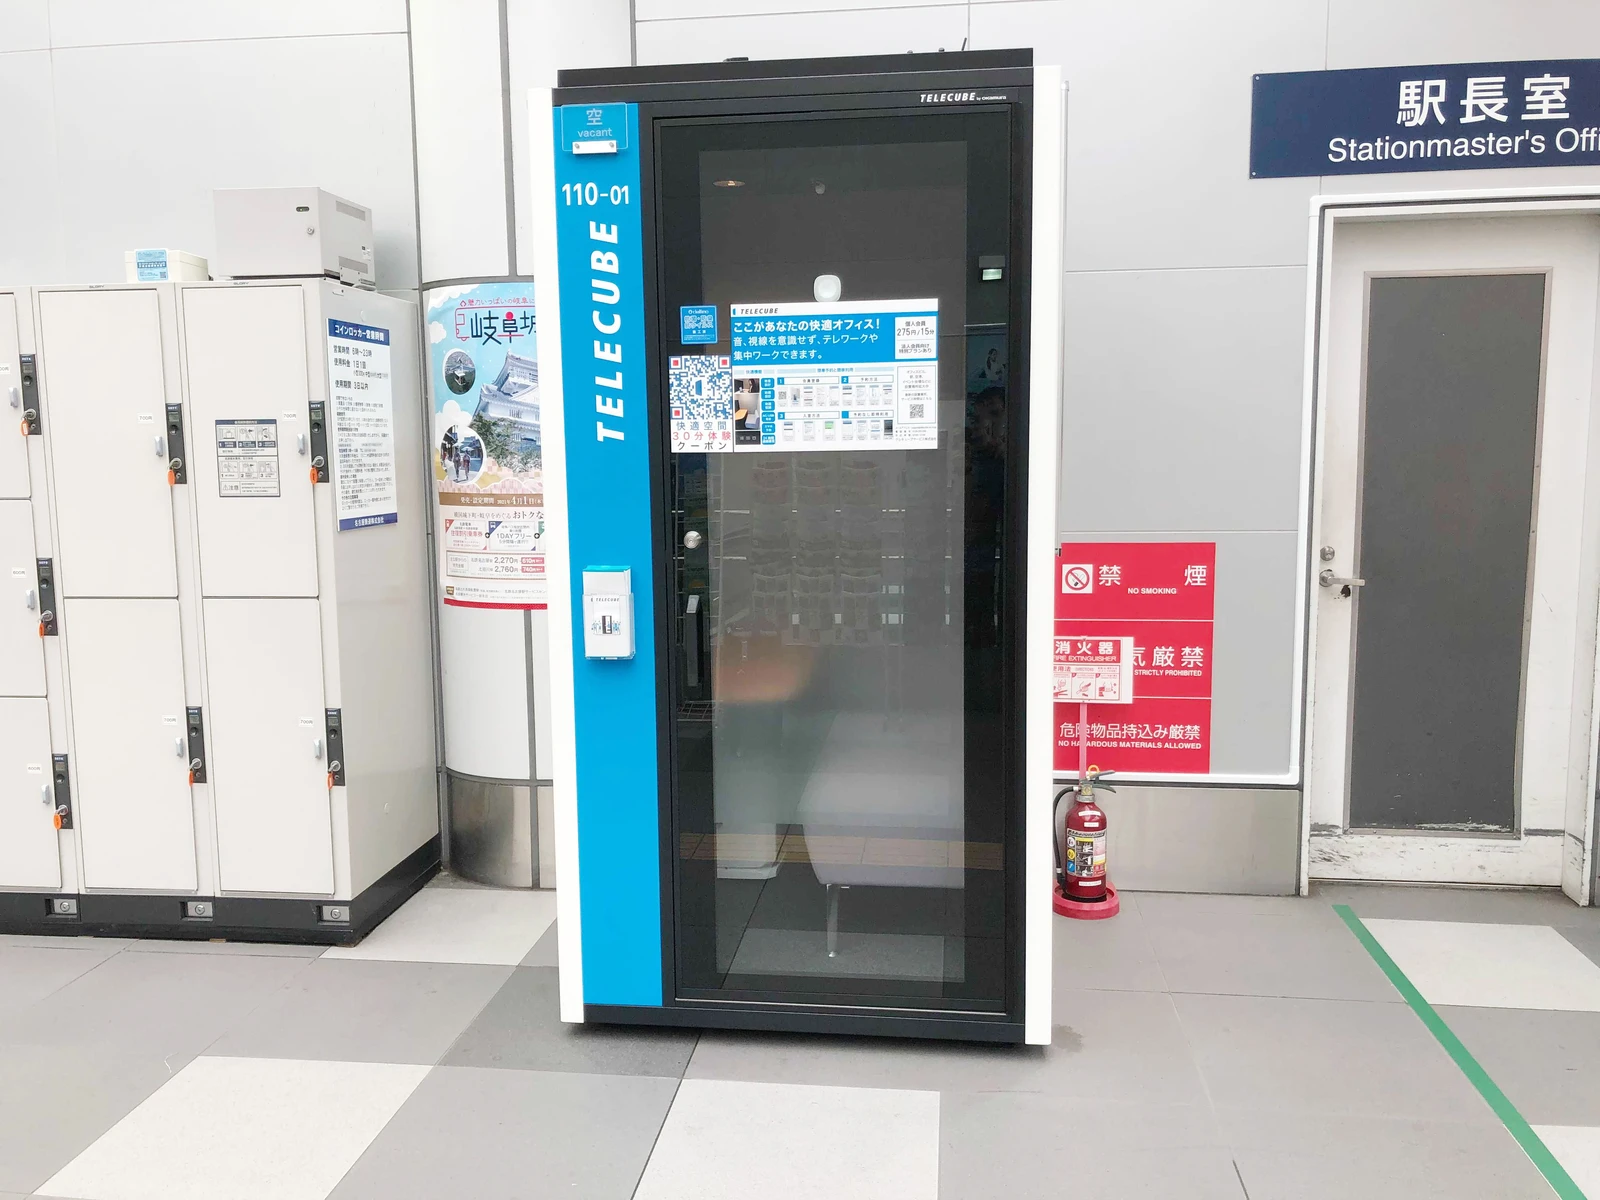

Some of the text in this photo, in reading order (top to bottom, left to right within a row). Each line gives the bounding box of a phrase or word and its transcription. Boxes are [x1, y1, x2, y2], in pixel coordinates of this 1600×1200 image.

[920, 92, 976, 103] TELECUBE
[1396, 73, 1570, 127] 駅長室
[586, 108, 603, 126] 空
[577, 127, 612, 138] vacant
[1328, 129, 1546, 163] Stationmaster's
[562, 182, 629, 206] 110-01
[335, 325, 384, 341] コインロッカー営業時間
[589, 220, 624, 442] TELECUBE
[897, 327, 935, 336] 275円/15分
[733, 333, 878, 347] 音、視線を意識せず、テレワークや
[333, 345, 350, 355] 営業時間
[733, 349, 822, 360] 集中ワークできます。
[676, 421, 727, 430] 快適空間
[673, 431, 731, 440] 30分体験
[678, 441, 727, 450] クーポン
[1055, 641, 1113, 655] 消火器
